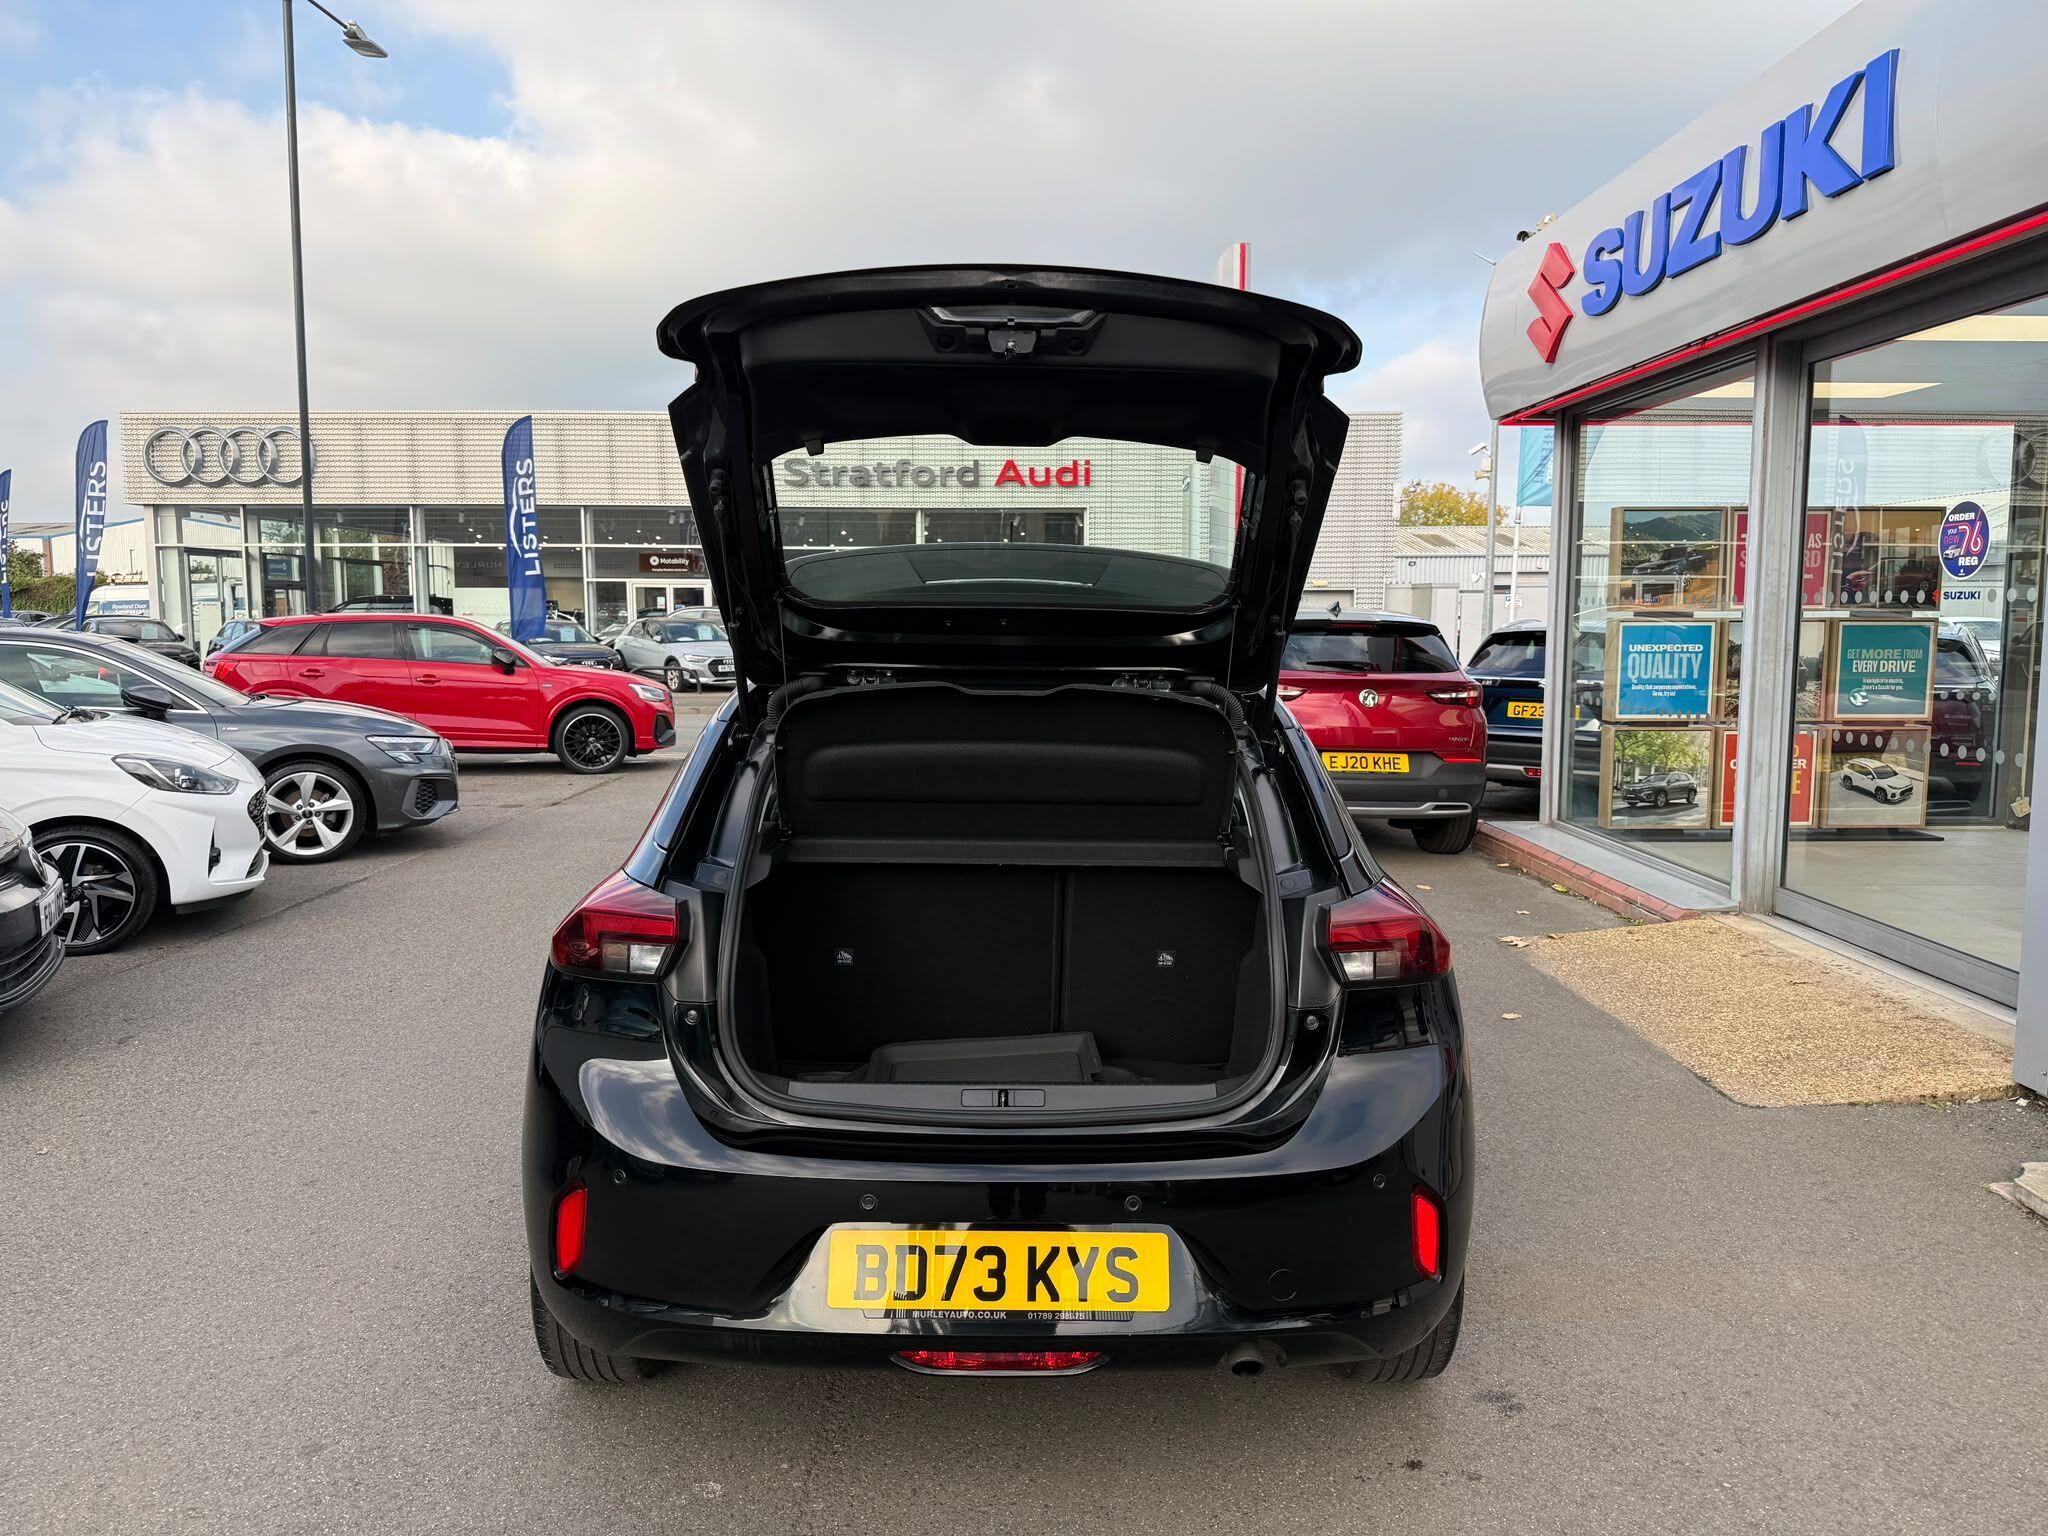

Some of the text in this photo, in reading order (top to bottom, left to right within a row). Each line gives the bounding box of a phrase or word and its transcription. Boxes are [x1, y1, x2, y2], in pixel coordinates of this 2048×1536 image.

[1581, 48, 1900, 317] SUZUKI
[783, 458, 1093, 488] Stratford Audi
[516, 458, 542, 576] LISTERS
[1948, 512, 1976, 522] ORDER
[1807, 533, 1823, 549] AS
[1943, 536, 1960, 544] new
[1958, 518, 1983, 555] 76
[1958, 556, 1979, 567] REG
[1943, 591, 1981, 600] SUZUKI
[1629, 644, 1704, 652] UNEXPECTED
[1847, 649, 1923, 660] GET MORE FROM
[1627, 653, 1703, 683] QUALITY
[1852, 660, 1916, 673] EVERY DRIVE
[1329, 755, 1402, 771] EJ20 KHE
[853, 1244, 1140, 1304] BD73 KYS
[912, 1310, 1007, 1319] MURLEYAUTO.CO.UK
[1027, 1312, 1053, 1320] 01789
